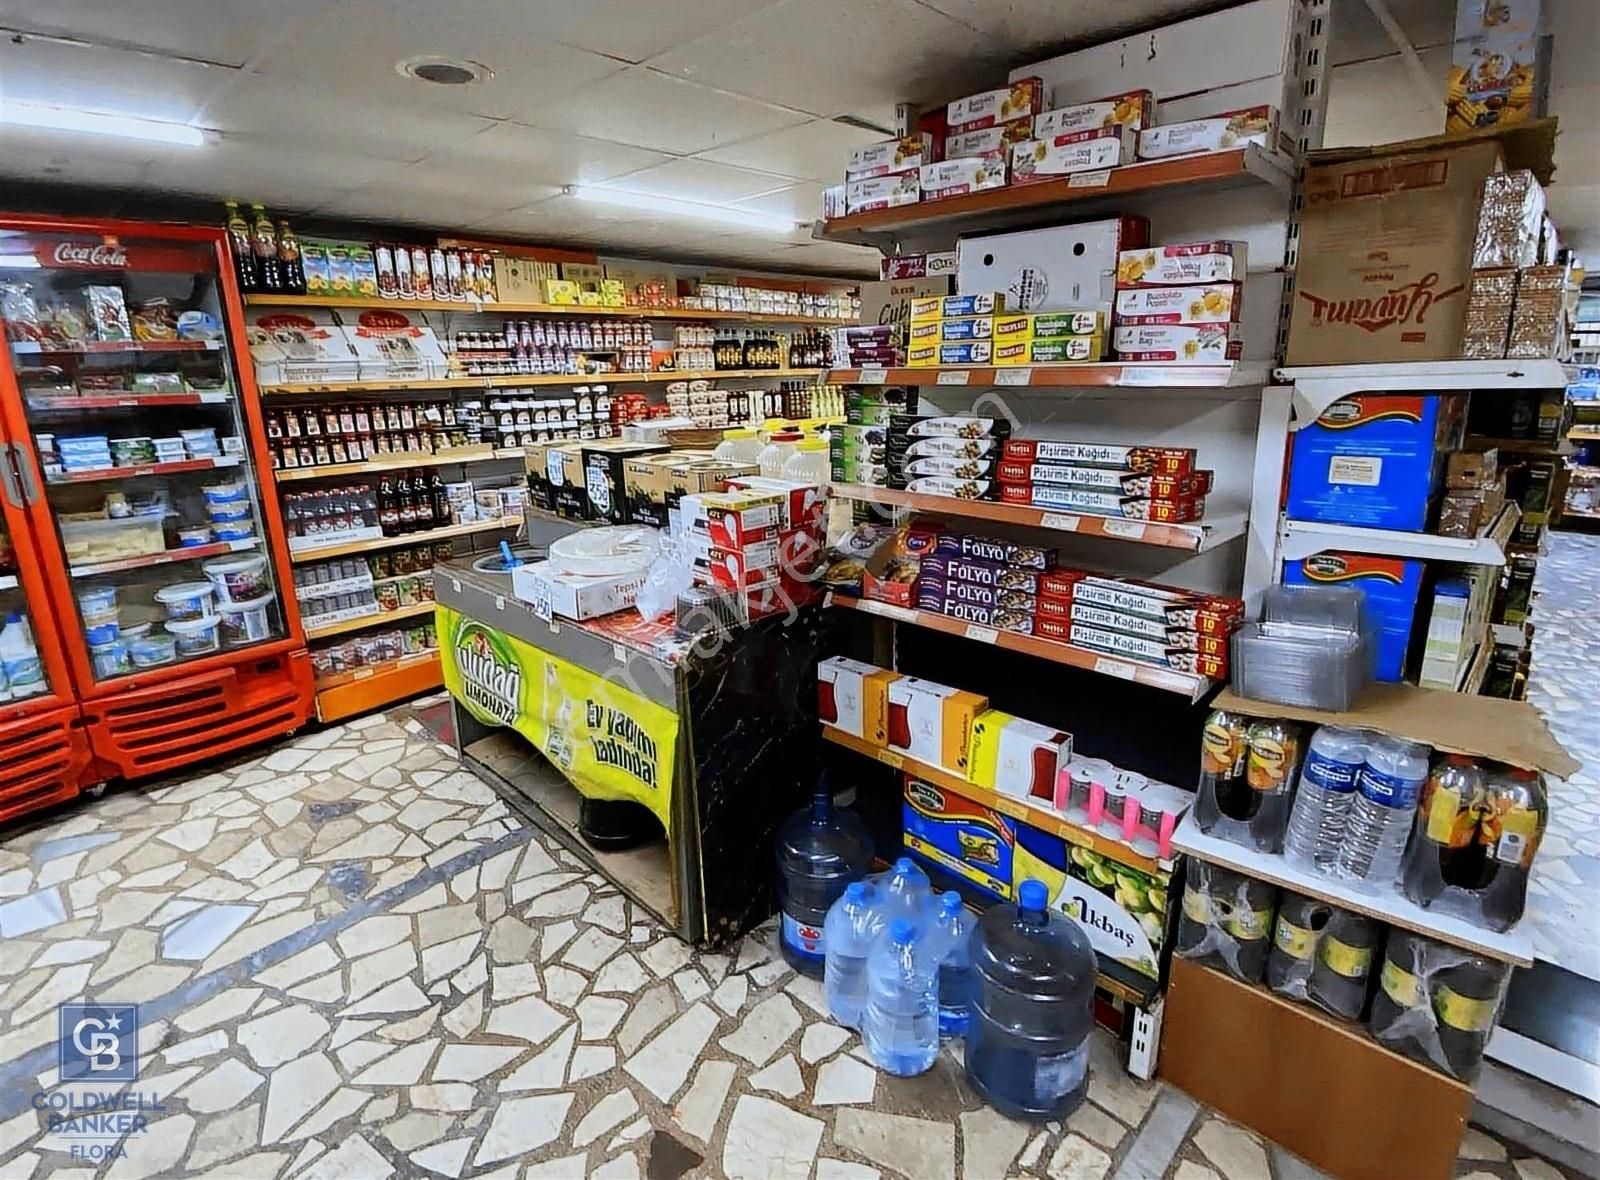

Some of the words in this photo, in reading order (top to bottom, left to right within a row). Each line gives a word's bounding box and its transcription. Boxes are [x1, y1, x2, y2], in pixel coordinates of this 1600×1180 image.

[54, 242, 129, 266] Coca-Cola
[1166, 458, 1179, 470] 10
[1158, 483, 1171, 495] 10
[1157, 506, 1169, 518] 10
[962, 538, 1004, 560] FOLYO
[947, 561, 992, 584] FOLYO
[946, 580, 992, 604] FOLYO
[944, 599, 989, 623] FOLYO
[1203, 618, 1215, 630] 10
[1205, 639, 1217, 651] 10
[456, 641, 520, 713] uludağ
[1205, 661, 1217, 673] 10
[586, 698, 604, 729] Ev
[607, 708, 658, 763] yapımı
